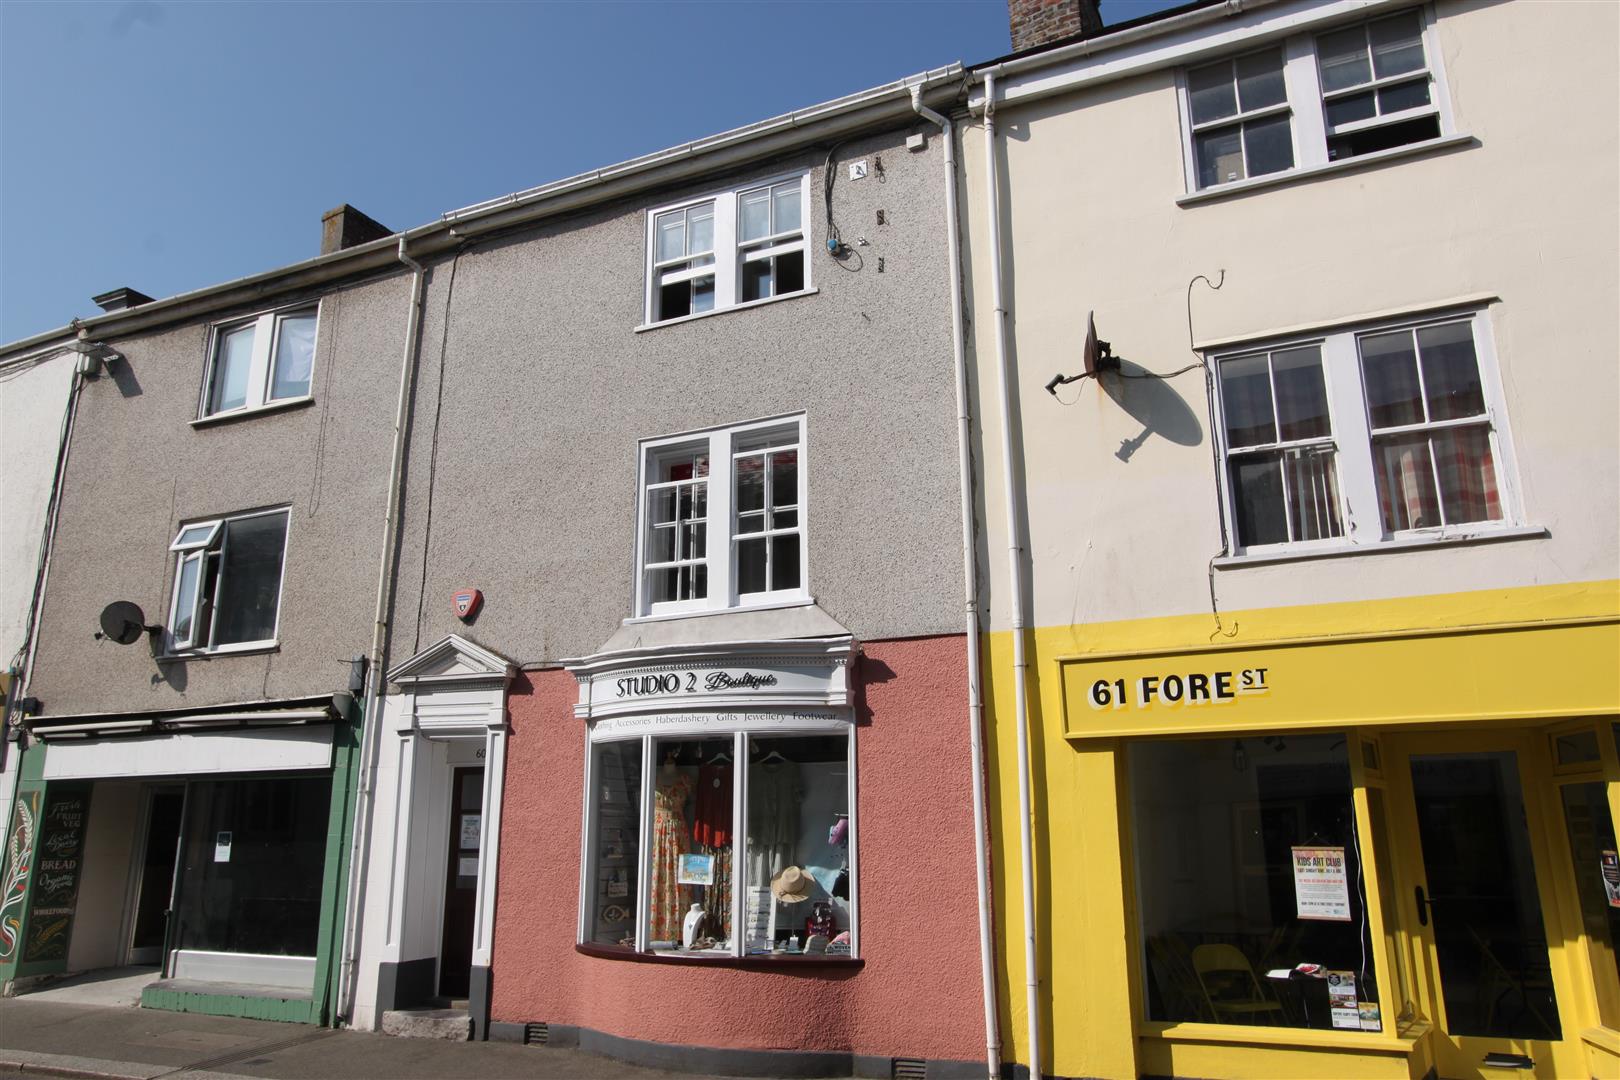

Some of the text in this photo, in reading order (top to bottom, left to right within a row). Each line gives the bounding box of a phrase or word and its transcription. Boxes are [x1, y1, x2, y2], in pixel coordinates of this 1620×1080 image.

[616, 671, 778, 697] STUDIO 2 Boutique
[1091, 668, 1269, 706] 61 FORE ST
[615, 718, 652, 728] Accessories
[655, 714, 711, 725] Haberdashery
[716, 711, 738, 721] Gifts
[744, 711, 787, 723] Jewellery
[792, 710, 837, 721] Footwear
[56, 811, 82, 821] FRUIT
[63, 820, 81, 828] VEG
[41, 860, 77, 870] BREAD
[1296, 856, 1342, 867] KIDS ART CLUB
